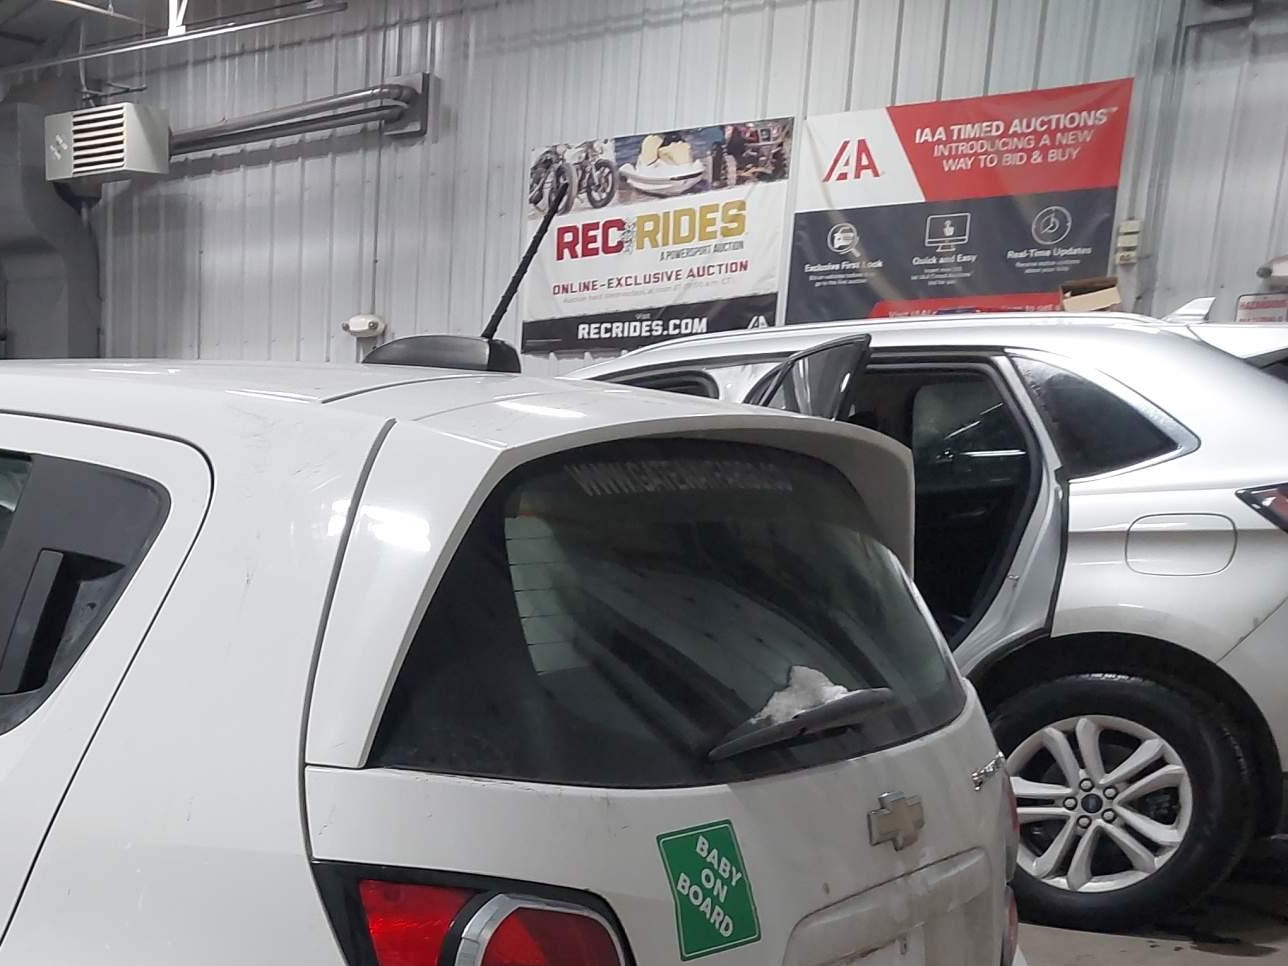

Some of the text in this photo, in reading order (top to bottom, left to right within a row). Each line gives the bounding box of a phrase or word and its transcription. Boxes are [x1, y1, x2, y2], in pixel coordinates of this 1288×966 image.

[915, 128, 946, 143] IAA
[950, 121, 1004, 140] TIMED
[934, 129, 1094, 157] INTRODUCING A NEW
[943, 147, 1080, 171] WAY TO BID & BUY
[556, 218, 626, 261] REC
[636, 200, 747, 250] RIDES
[713, 241, 744, 254] AUCTION
[912, 256, 937, 266] Quick
[957, 254, 977, 264] Easy
[552, 269, 682, 295] ONLINE-EXCLUSIVE
[687, 260, 748, 279] AUCTION
[577, 317, 708, 339] RECRIDES.COM
[696, 835, 742, 886] BABY
[701, 868, 728, 903] ON
[677, 872, 733, 937] BOARD
